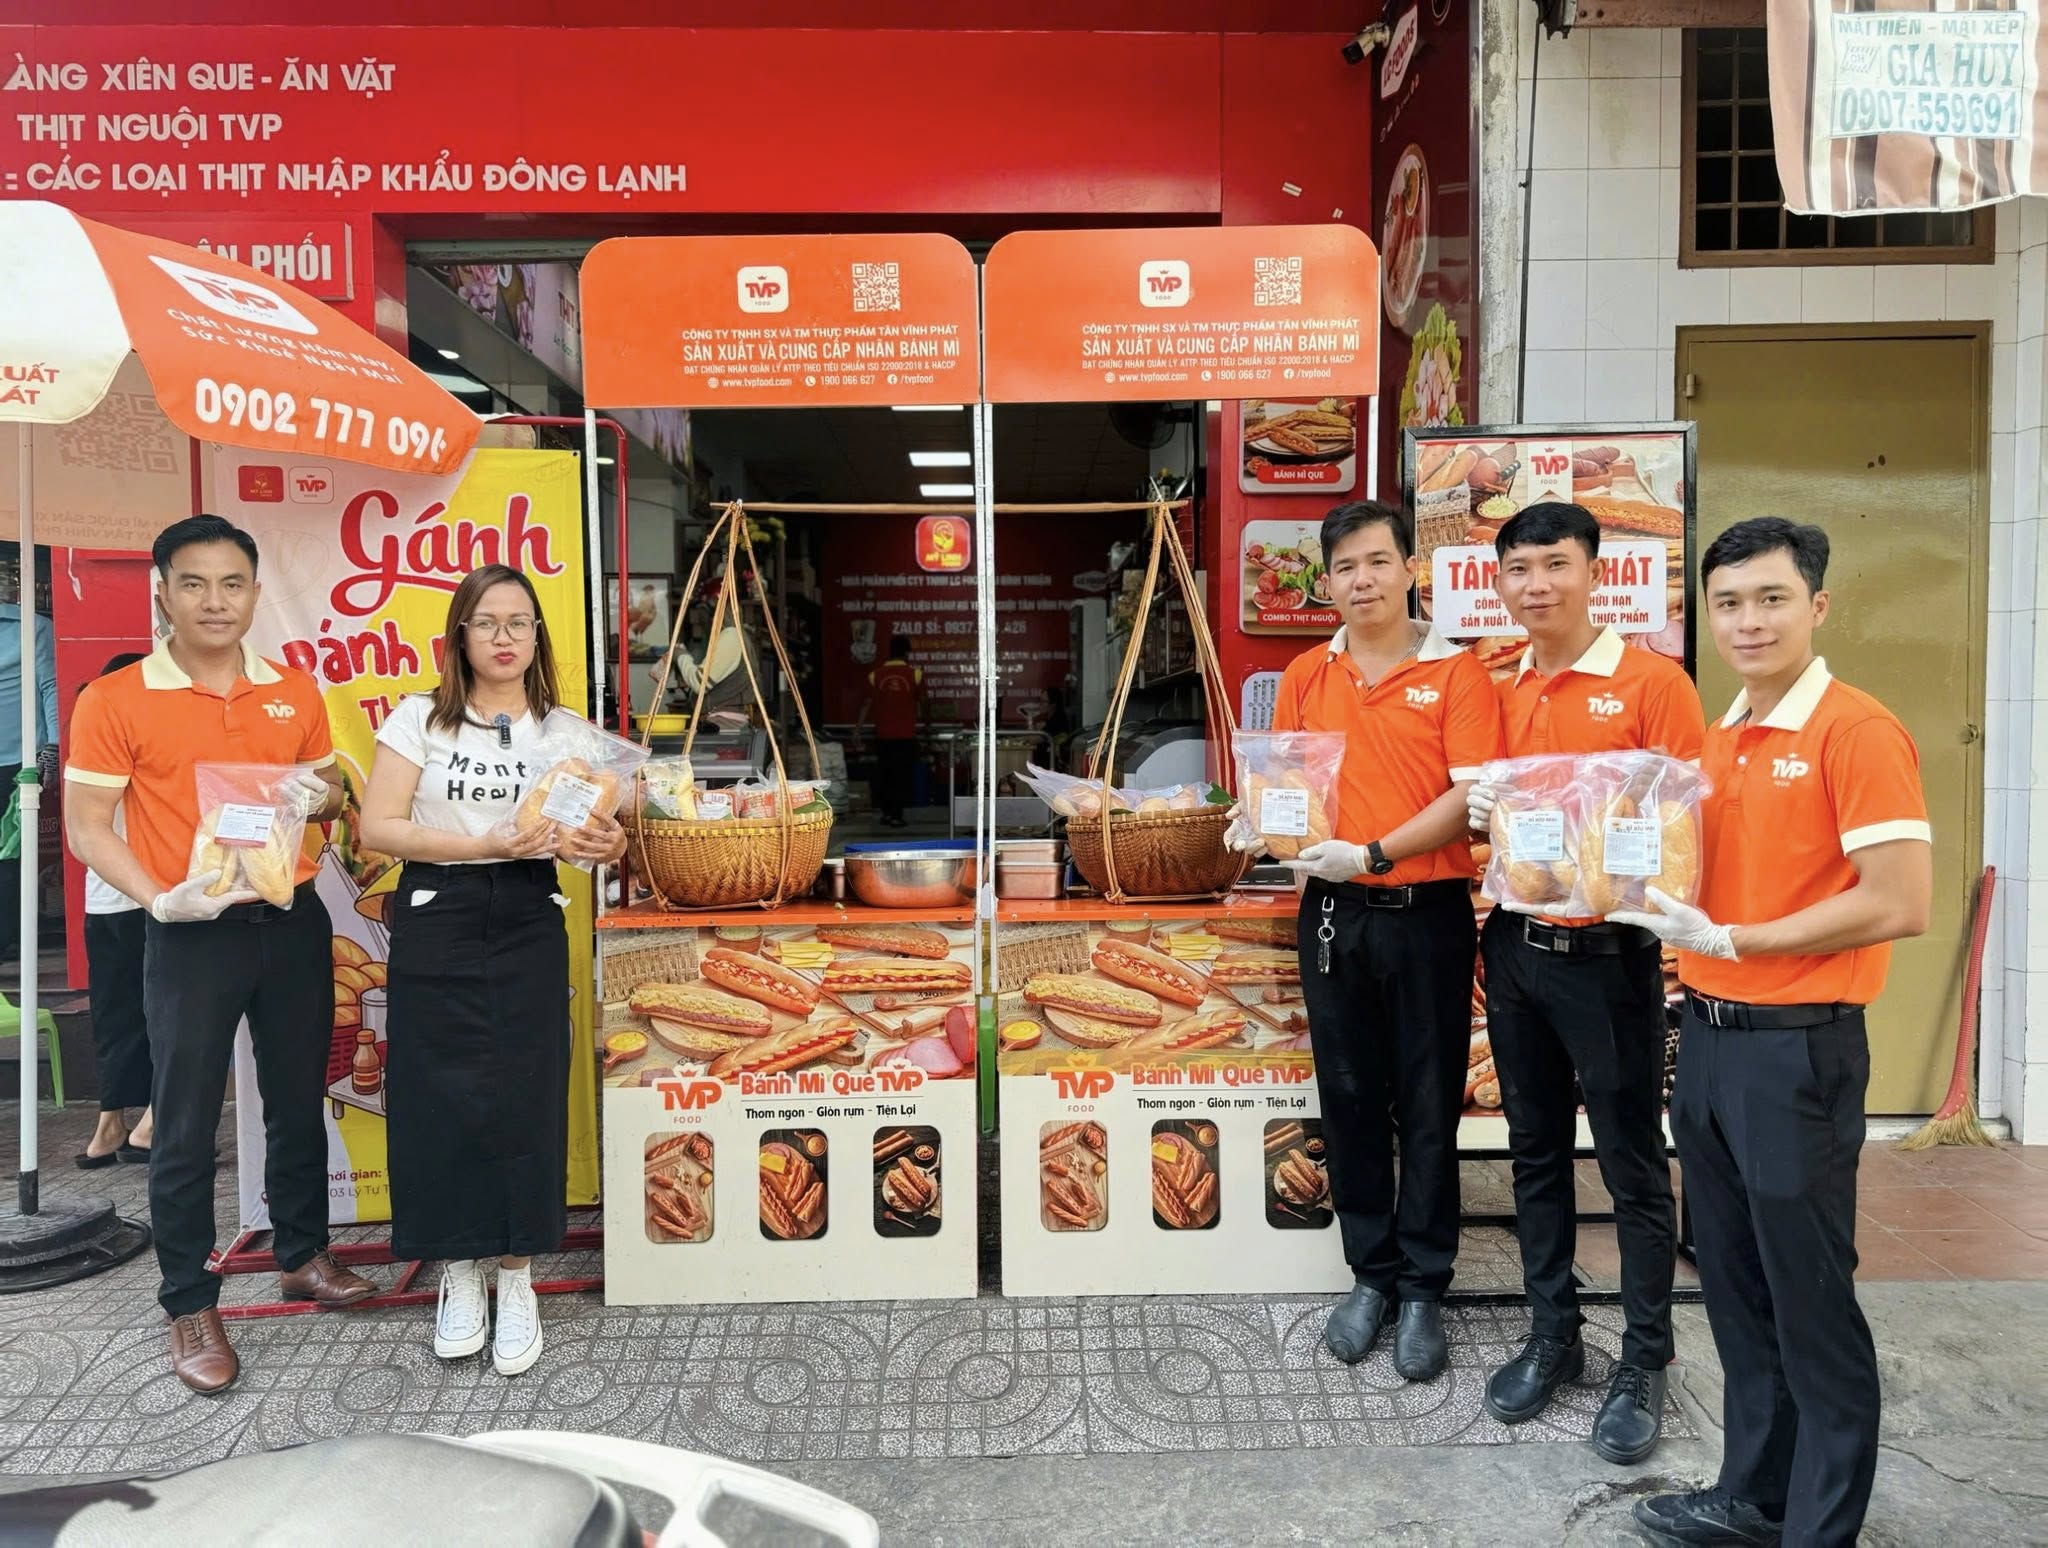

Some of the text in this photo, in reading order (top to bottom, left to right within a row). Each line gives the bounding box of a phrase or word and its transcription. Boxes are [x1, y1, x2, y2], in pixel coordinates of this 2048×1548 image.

[1839, 18, 1870, 35] MÁI
[1877, 17, 1922, 36] HIÊN
[1984, 15, 2019, 35] XẾP
[1888, 43, 2019, 87] GIA HUY
[101, 57, 176, 91] XIÊN
[187, 62, 254, 92] QUE
[280, 57, 329, 91] ĂN
[340, 56, 396, 98] VẶT
[1840, 88, 2016, 133] 0907.559691
[17, 106, 282, 149] THỊT NGUỘI TVP
[26, 154, 101, 192] CÁC
[112, 163, 187, 197] LOẠI
[198, 165, 266, 197] THỊT
[278, 157, 371, 198] NHẬP
[381, 150, 472, 192] KHẨU
[483, 158, 587, 192] ĐÔNG
[598, 165, 686, 199] LẠNH
[252, 232, 332, 281] PHỐI
[745, 282, 781, 298] TVP
[1147, 276, 1182, 292] TVP
[167, 308, 222, 330] Chất
[225, 322, 299, 349] Lượng
[299, 339, 348, 360] Hôm
[682, 327, 713, 340] CÔNG
[715, 328, 729, 339] TY
[731, 328, 761, 339] TNHH
[763, 328, 778, 338] SX
[779, 326, 792, 338] VÀ
[793, 328, 810, 338] TM
[812, 325, 841, 339] THỰC
[878, 324, 900, 336] TÂN
[902, 324, 928, 336] VĨNH
[930, 323, 959, 335] PHÁT
[1082, 323, 1112, 335] CÔNG
[1114, 324, 1128, 334] TY
[1131, 323, 1160, 333] TNHH
[1162, 323, 1176, 333] SX
[1178, 321, 1190, 333] VÀ
[1192, 322, 1209, 332] TM
[1211, 321, 1240, 334] THỰC
[1278, 318, 1299, 330] TÂN
[1301, 318, 1328, 329] VĨNH
[1330, 317, 1360, 329] PHÁT
[683, 337, 960, 361] SẢN XUẤT VÀ CUNG CẤP NHÂN BÁNH MÌ
[1082, 331, 1360, 356] SẢN XUẤT VÀ CUNG CẤP NHÂN BÁNH MÌ
[180, 325, 405, 385] Sức Ngày Mai
[1180, 358, 1198, 367] ATTP
[1200, 357, 1218, 367] THEO
[1264, 356, 1276, 365] ISO
[1330, 354, 1354, 364] HACCP
[783, 363, 801, 373] ATTP
[803, 363, 821, 373] THEO
[867, 362, 879, 372] ISO
[932, 360, 956, 370] HACCP
[722, 378, 793, 388] www.tvpfood.com
[821, 375, 840, 385] 1900
[842, 375, 858, 385] 066
[859, 375, 876, 385] 627
[1119, 372, 1189, 383] www.tvpfood.com
[1216, 369, 1236, 380] 1900
[1238, 369, 1254, 380] 066
[1256, 369, 1272, 379] 627
[195, 377, 297, 435] 0902
[310, 396, 375, 448] 777
[1531, 455, 1569, 475] TVP
[1274, 470, 1325, 480] BÁNH MÌ QUE
[1540, 478, 1558, 486] FOOD
[296, 479, 327, 492] TVP
[330, 490, 565, 617] Gánh
[1474, 597, 1501, 610] CÔNG
[1612, 595, 1632, 609] HẠN
[1263, 612, 1337, 625] COMBO THỊT NGUỘI
[1460, 613, 1480, 628] SẢN
[1483, 612, 1508, 627] XUẤT
[1620, 608, 1649, 623] PHẨM
[892, 621, 922, 634] ZALO
[1405, 687, 1440, 704] TVP
[262, 704, 296, 718] TVP
[1588, 697, 1624, 715] TVP
[1772, 759, 1809, 779] TVP
[741, 1071, 923, 1096] Bánh Mì Que TVP
[1132, 1064, 1313, 1087] Bánh Mì Que TVP
[1051, 1071, 1114, 1099] TVP
[657, 1082, 722, 1111] TVP
[1169, 1099, 1196, 1111] ngon
[1234, 1099, 1254, 1110] rụm
[1266, 1097, 1287, 1110] Tiện
[674, 1116, 702, 1124] FOOD
[778, 1109, 805, 1121] ngon
[844, 1107, 864, 1119] rụm
[876, 1105, 897, 1118] Tiện
[350, 1169, 382, 1182] gian:
[349, 1186, 361, 1199] Lý
[363, 1184, 380, 1196] Tự
